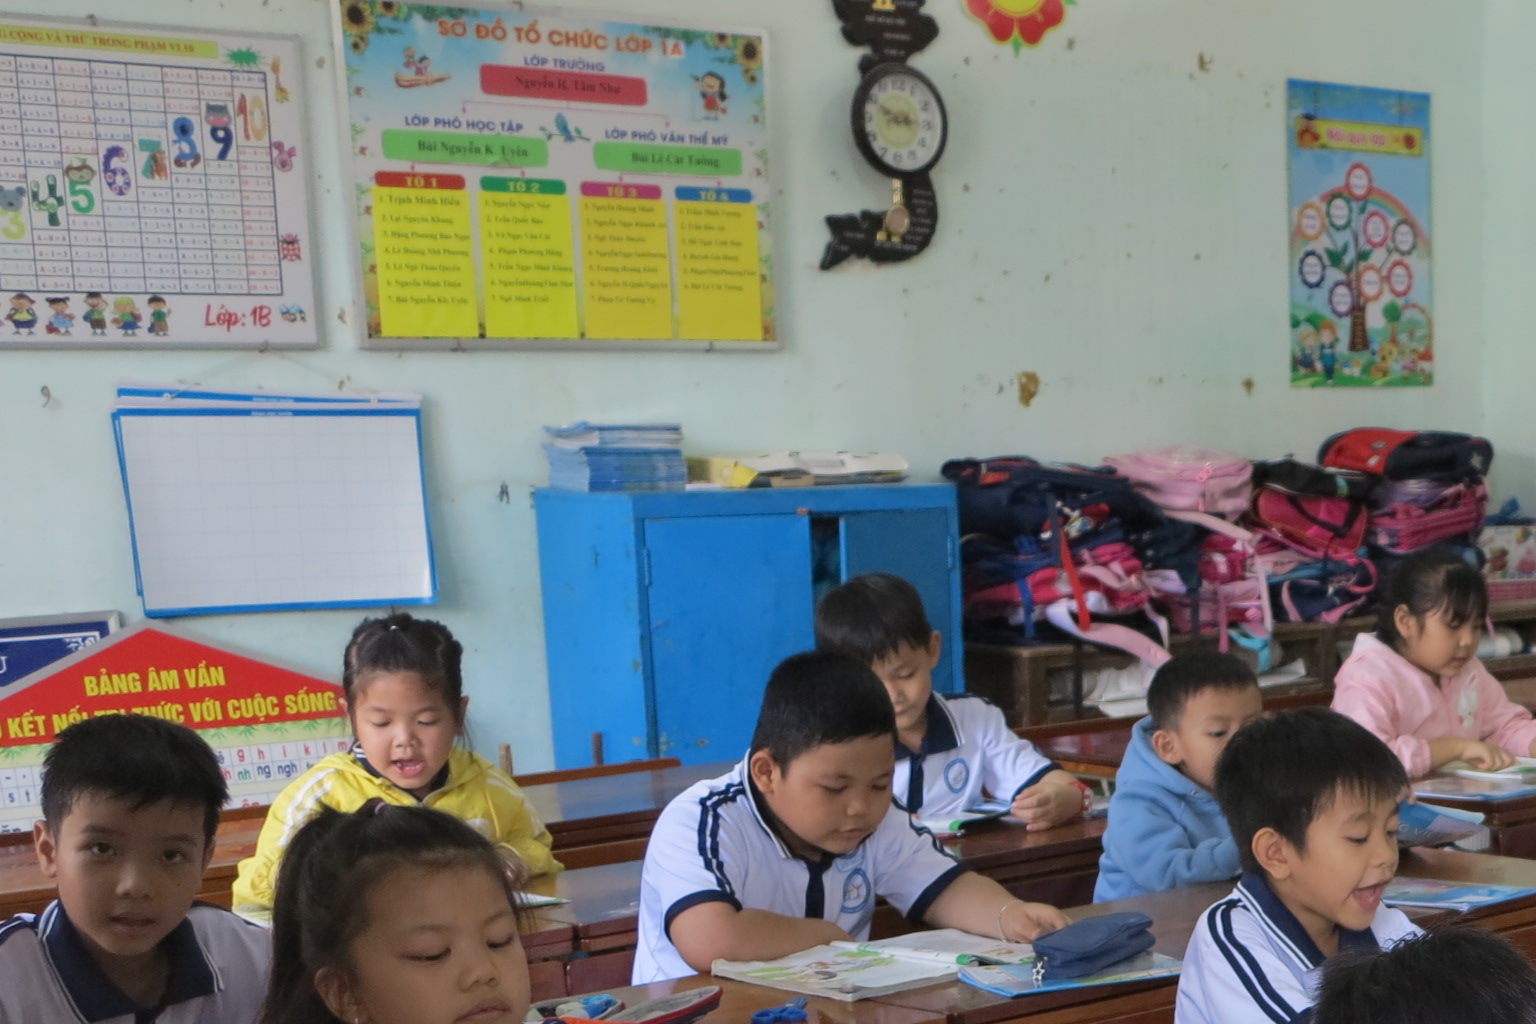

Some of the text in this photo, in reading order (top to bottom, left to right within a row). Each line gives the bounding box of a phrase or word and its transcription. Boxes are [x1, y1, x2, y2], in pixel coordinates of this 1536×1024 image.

[92, 36, 131, 48] TRONG
[170, 43, 180, 51] VI
[437, 17, 684, 57] SƠ ĐỒ TỔ CHỨC LỚP 1A
[523, 54, 606, 72] LỚP TRƯỞNG
[404, 116, 523, 135] LỚP PHÓ HỌC TẬP
[605, 127, 627, 139] LỚP
[631, 129, 656, 141] PHÓ
[210, 125, 233, 160] 9
[102, 145, 132, 196] 6
[29, 174, 65, 226] 4
[68, 177, 95, 214] 5
[529, 183, 540, 193] 2
[204, 304, 272, 332] Lớp: 1B
[84, 660, 226, 696] BẢNG ÂM VẦN
[8, 709, 46, 738] KẾT
[189, 697, 223, 722] VỚI
[227, 693, 280, 722] CUỘC
[285, 687, 337, 714] SỐNG
[237, 749, 245, 762] g
[258, 748, 264, 760] h
[238, 769, 251, 780] nh
[257, 765, 271, 778] ng
[278, 762, 297, 777] ngh
